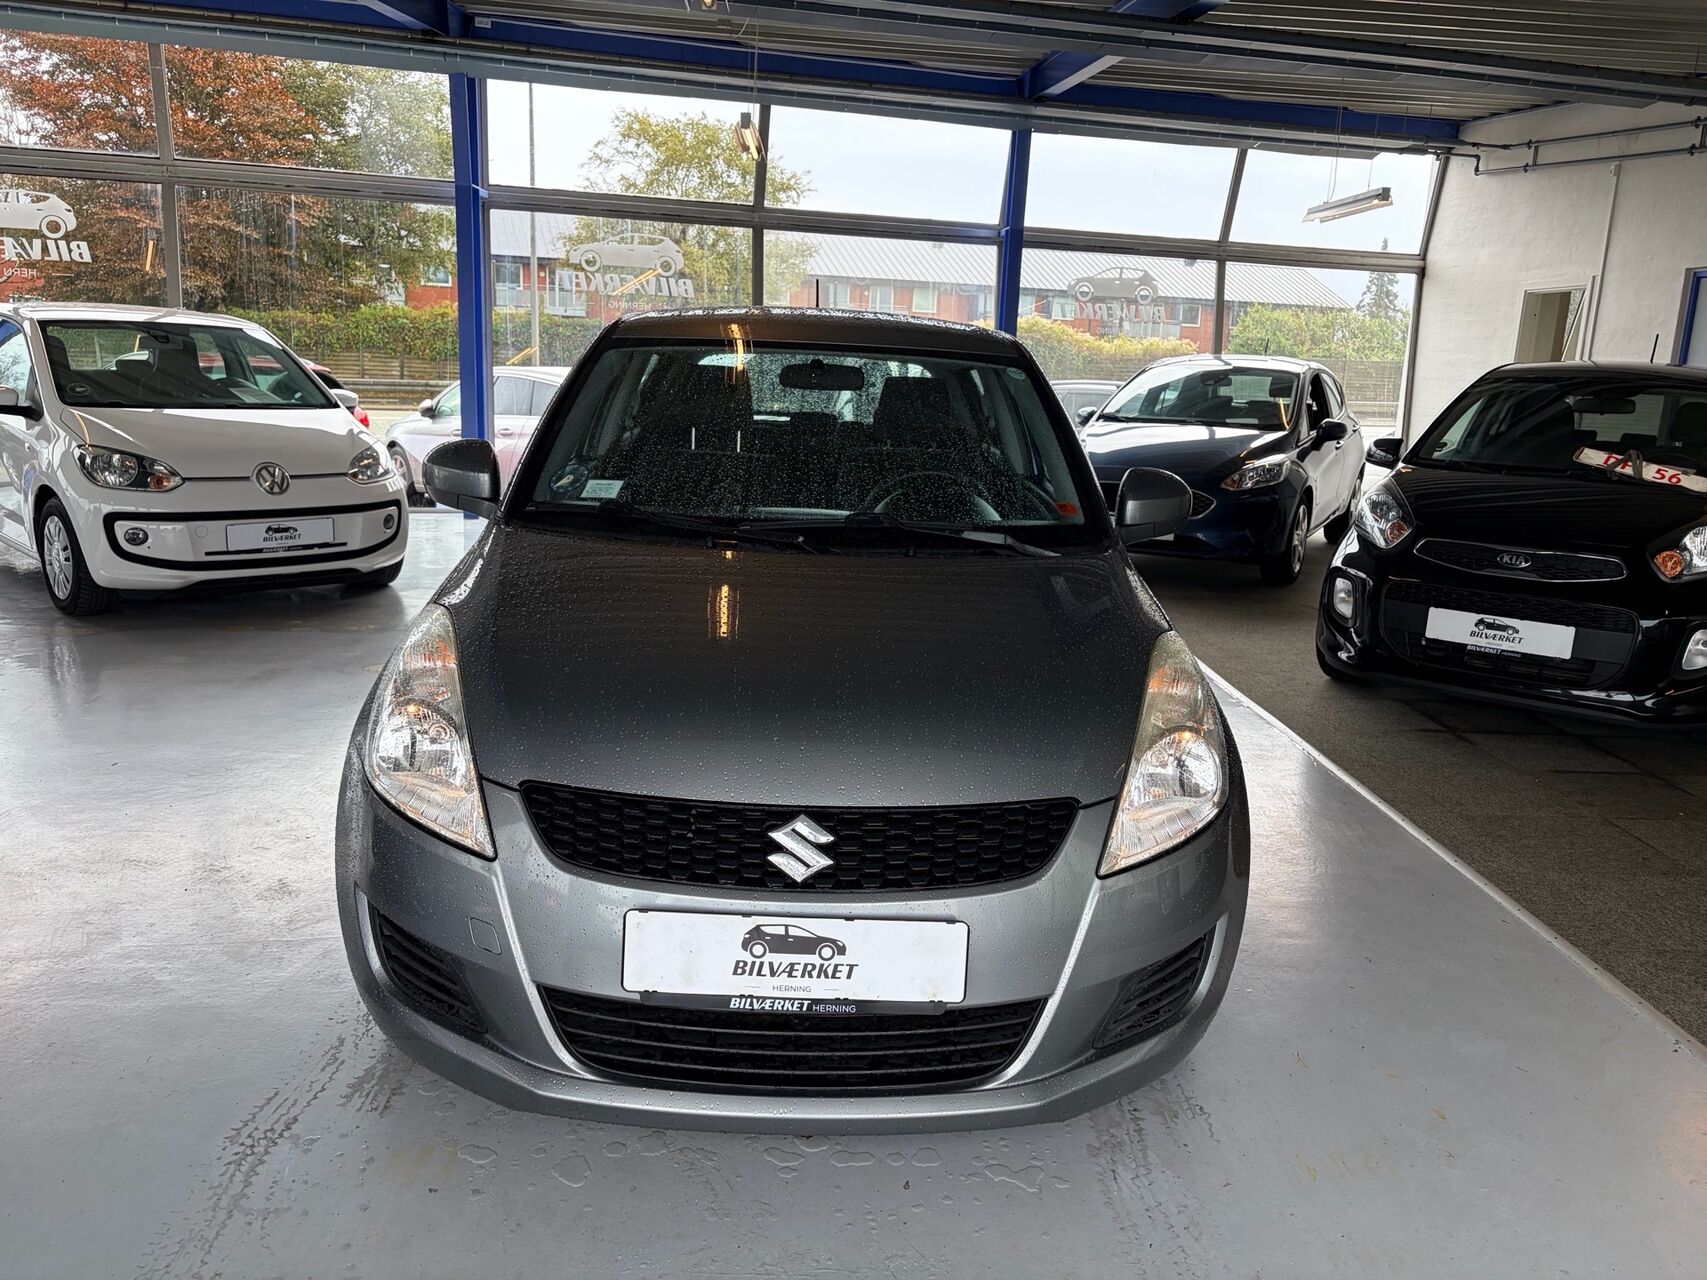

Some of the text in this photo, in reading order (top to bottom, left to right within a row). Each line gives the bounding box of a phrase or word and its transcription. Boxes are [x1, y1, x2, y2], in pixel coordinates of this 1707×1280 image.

[1653, 467, 1682, 484] 56
[1503, 553, 1525, 565] KIA
[1469, 630, 1524, 645] BILVÆRKET
[732, 959, 859, 980] BILVÆRKET
[772, 984, 812, 993] HERNING
[729, 997, 857, 1013] BILVÆRKET HERNING
